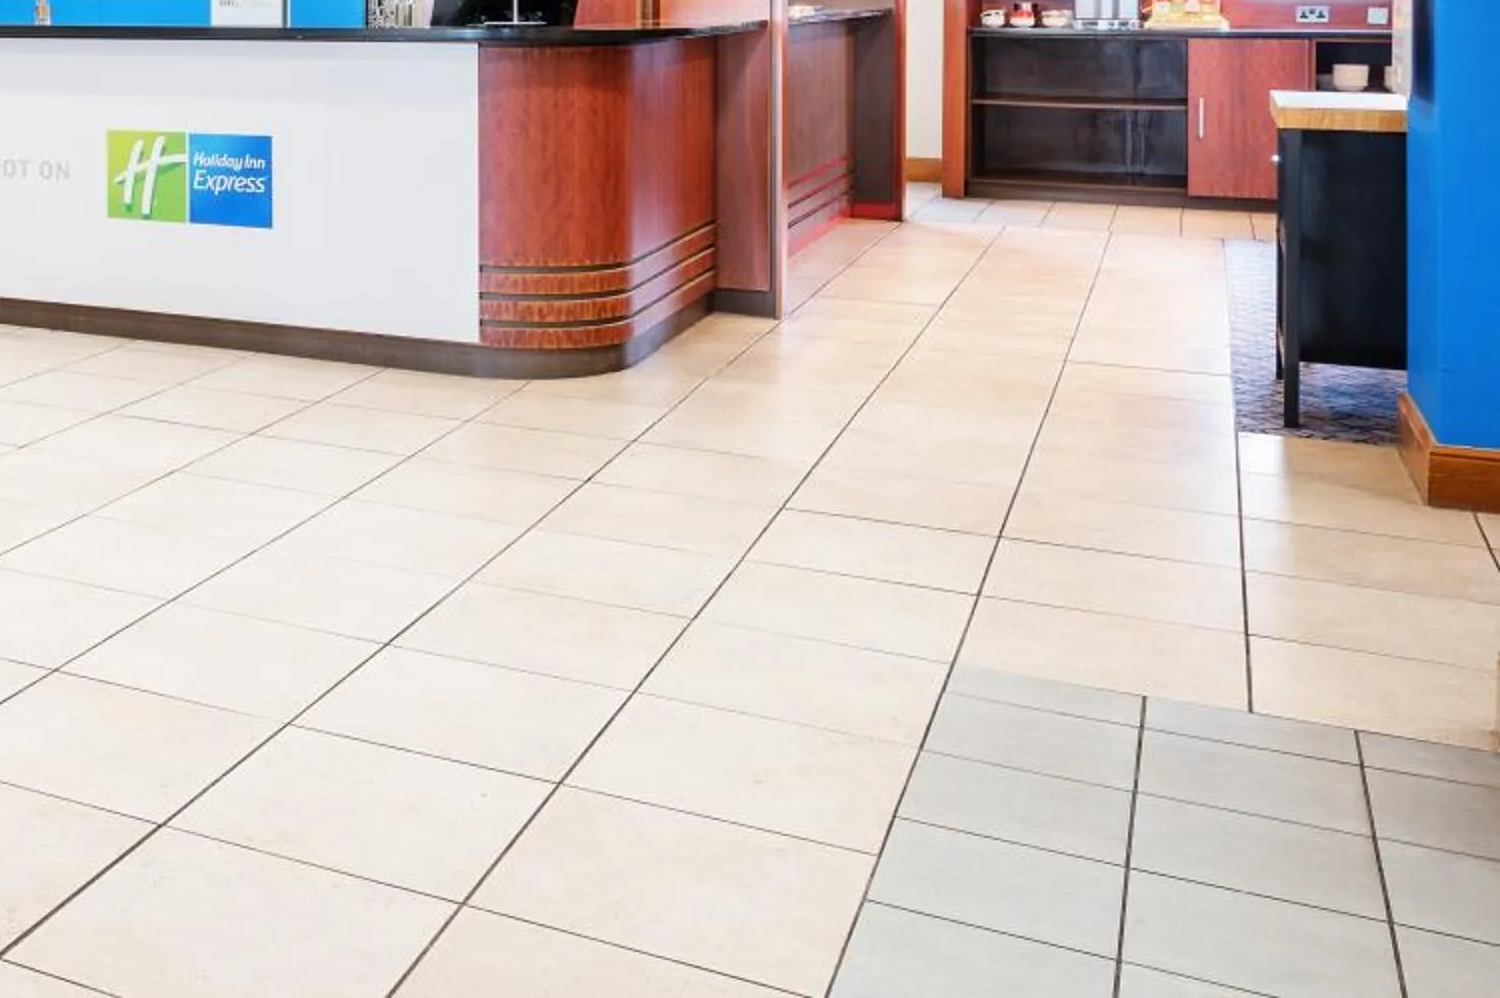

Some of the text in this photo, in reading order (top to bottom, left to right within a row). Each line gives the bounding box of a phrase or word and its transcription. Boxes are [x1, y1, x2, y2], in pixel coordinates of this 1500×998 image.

[38, 160, 70, 181] ON
[193, 151, 266, 172] Holiday Inn
[114, 136, 188, 215] H
[192, 169, 266, 196] Express
